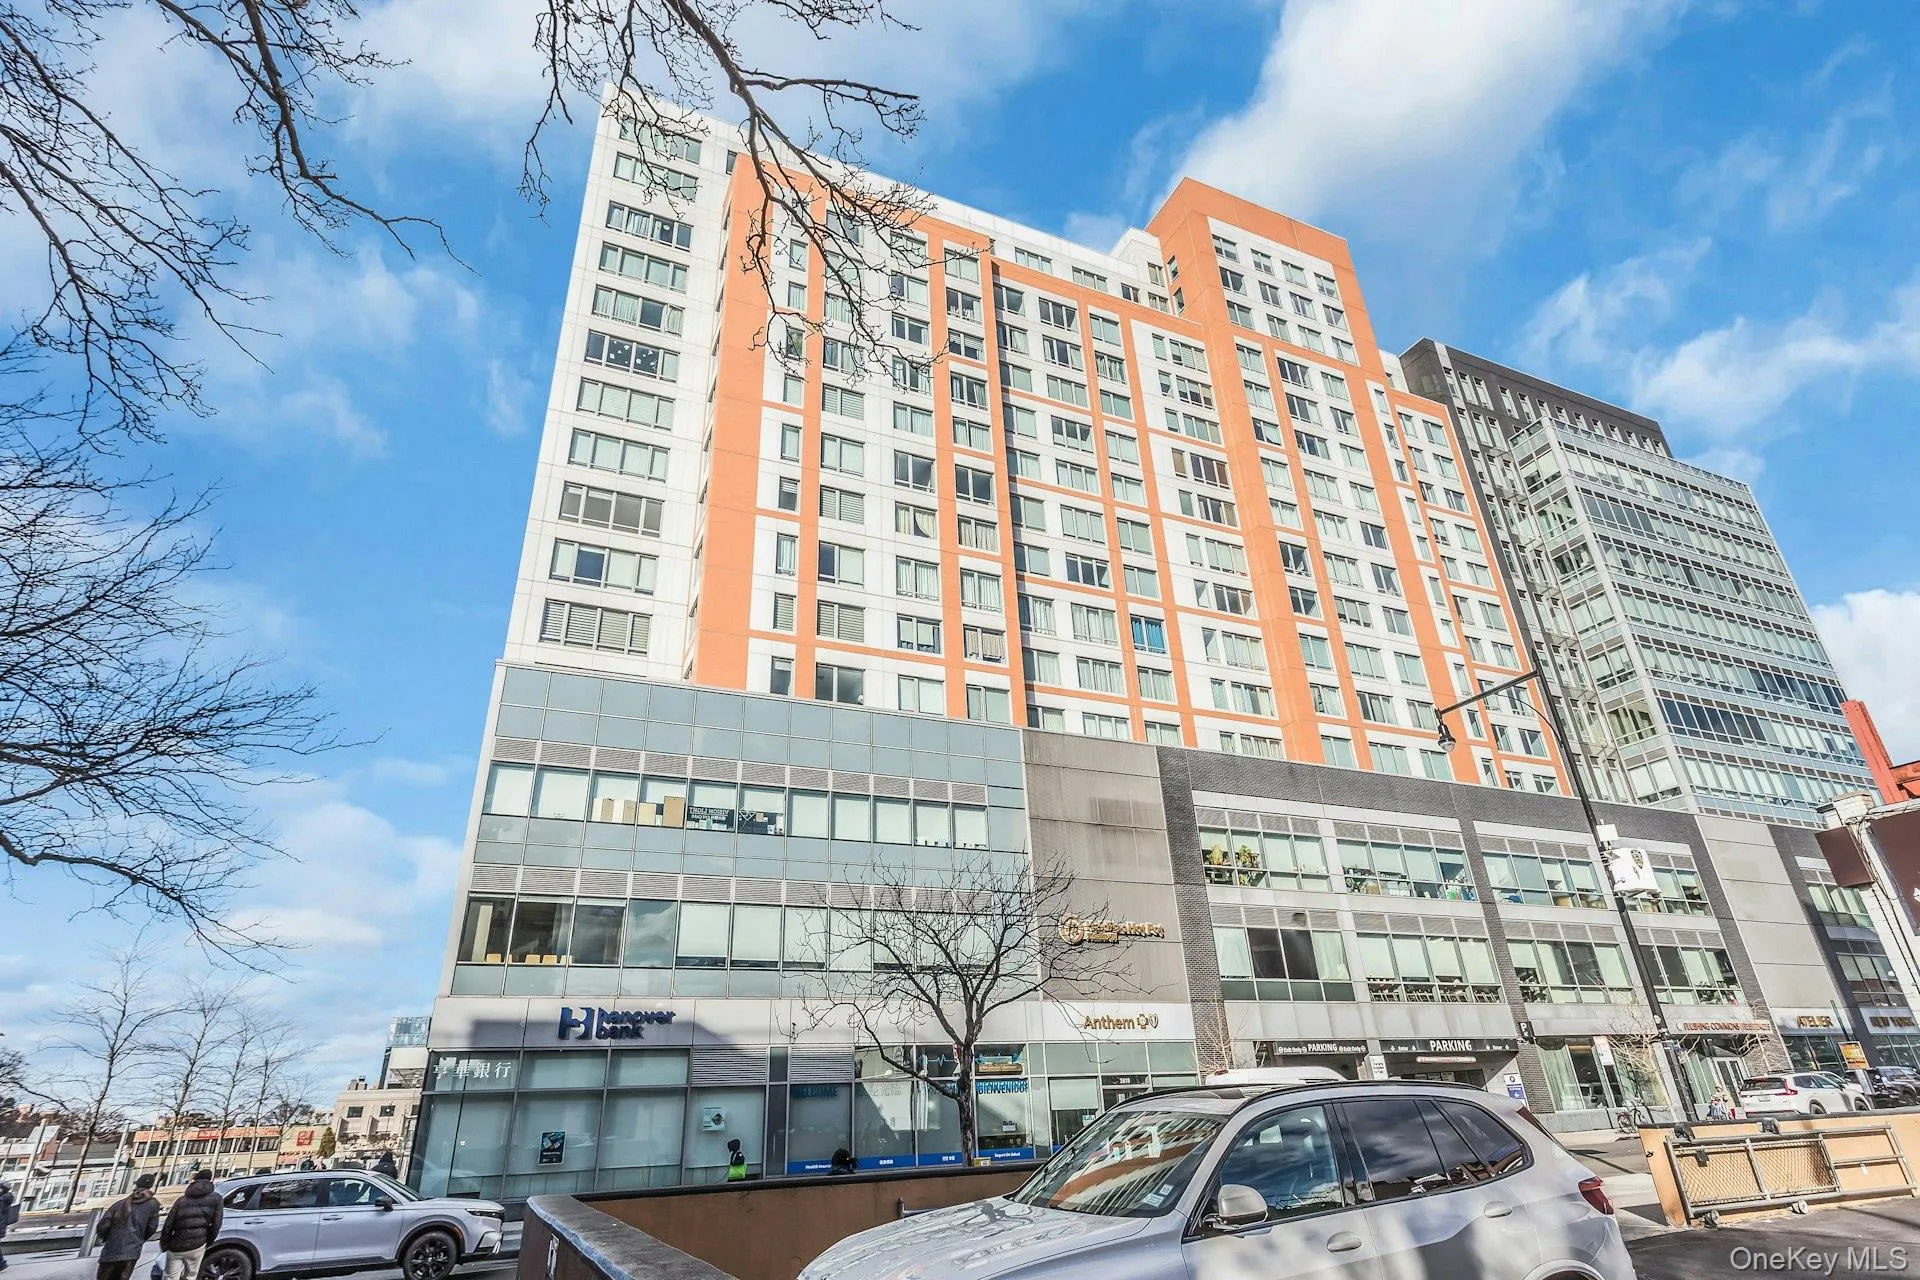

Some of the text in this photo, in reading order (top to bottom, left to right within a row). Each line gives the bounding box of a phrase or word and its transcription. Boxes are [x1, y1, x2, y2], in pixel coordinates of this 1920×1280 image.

[598, 1007, 676, 1025] hanover
[1083, 1015, 1135, 1030] Anthem
[1520, 1022, 1528, 1031] P
[596, 1023, 644, 1040] bank
[1307, 1043, 1337, 1052] PARKING
[1430, 1040, 1472, 1051] PARKING
[791, 1086, 838, 1098] WELCOME
